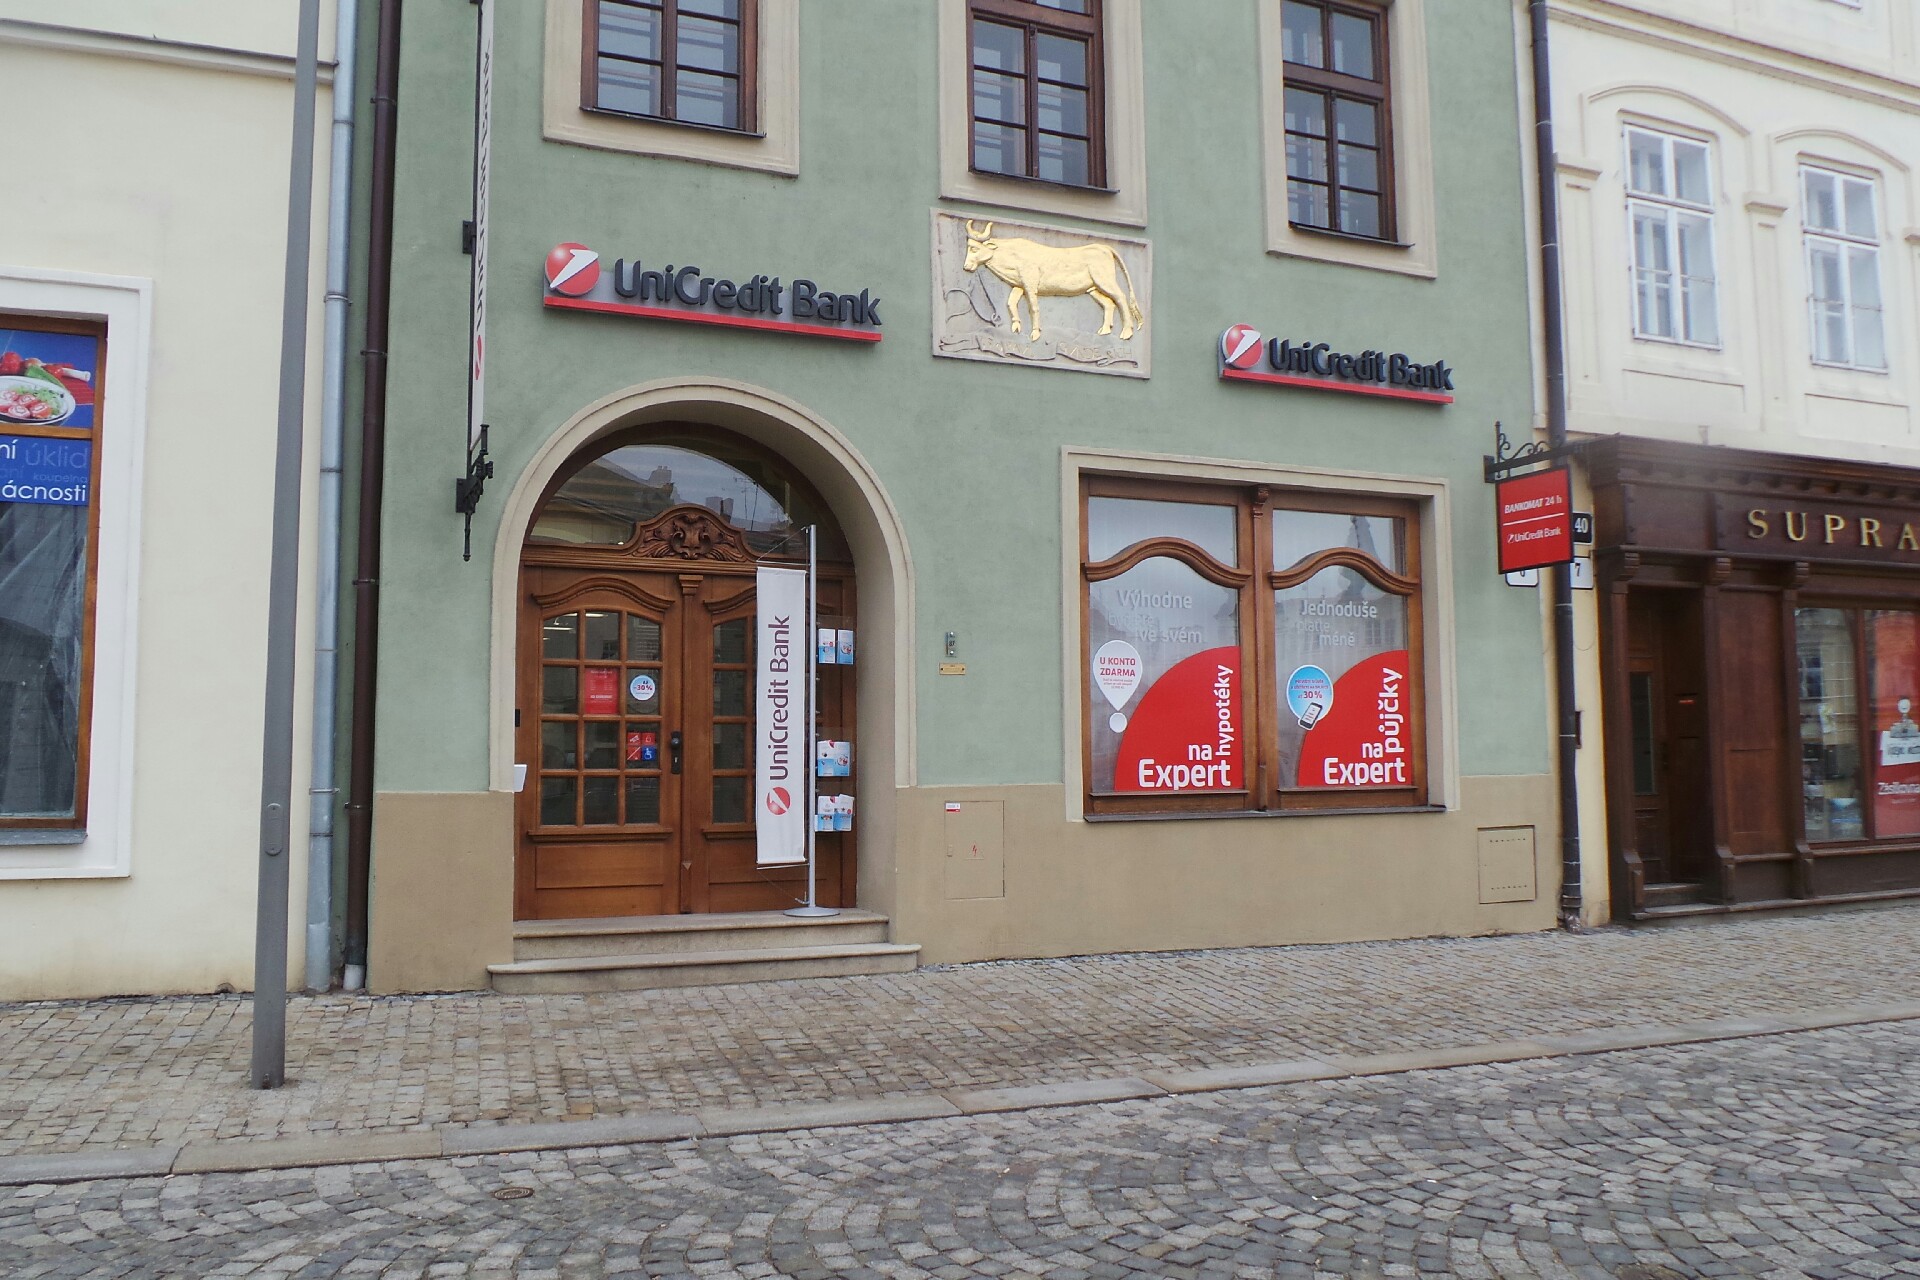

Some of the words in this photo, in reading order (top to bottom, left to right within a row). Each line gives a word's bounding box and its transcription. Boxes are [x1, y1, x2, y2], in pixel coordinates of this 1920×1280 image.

[614, 258, 783, 315] UniCredit
[792, 279, 882, 326] Bank
[1268, 337, 1387, 382] UniCredit
[1389, 353, 1454, 390] Bank
[25, 443, 88, 468] úklid
[2, 480, 87, 502] ácnosti
[1504, 498, 1544, 514] BANKOMAT
[1544, 496, 1555, 506] 24
[1515, 530, 1544, 543] UniCredit
[1544, 526, 1562, 537] Bank
[1300, 599, 1378, 619] Jednoduše
[767, 615, 791, 673] Bank
[1318, 631, 1356, 647] méně
[1099, 657, 1106, 665] U
[1107, 657, 1136, 666] KONTO
[1099, 667, 1136, 677] ZDARMA
[1303, 690, 1314, 699] 30
[1213, 664, 1235, 756] hypotéky
[1377, 667, 1405, 753] půjčky
[767, 678, 789, 781] UniCredit
[1188, 744, 1213, 761] na
[1361, 742, 1384, 758] na
[1138, 758, 1231, 791] Expert
[1324, 757, 1406, 786] Expert
